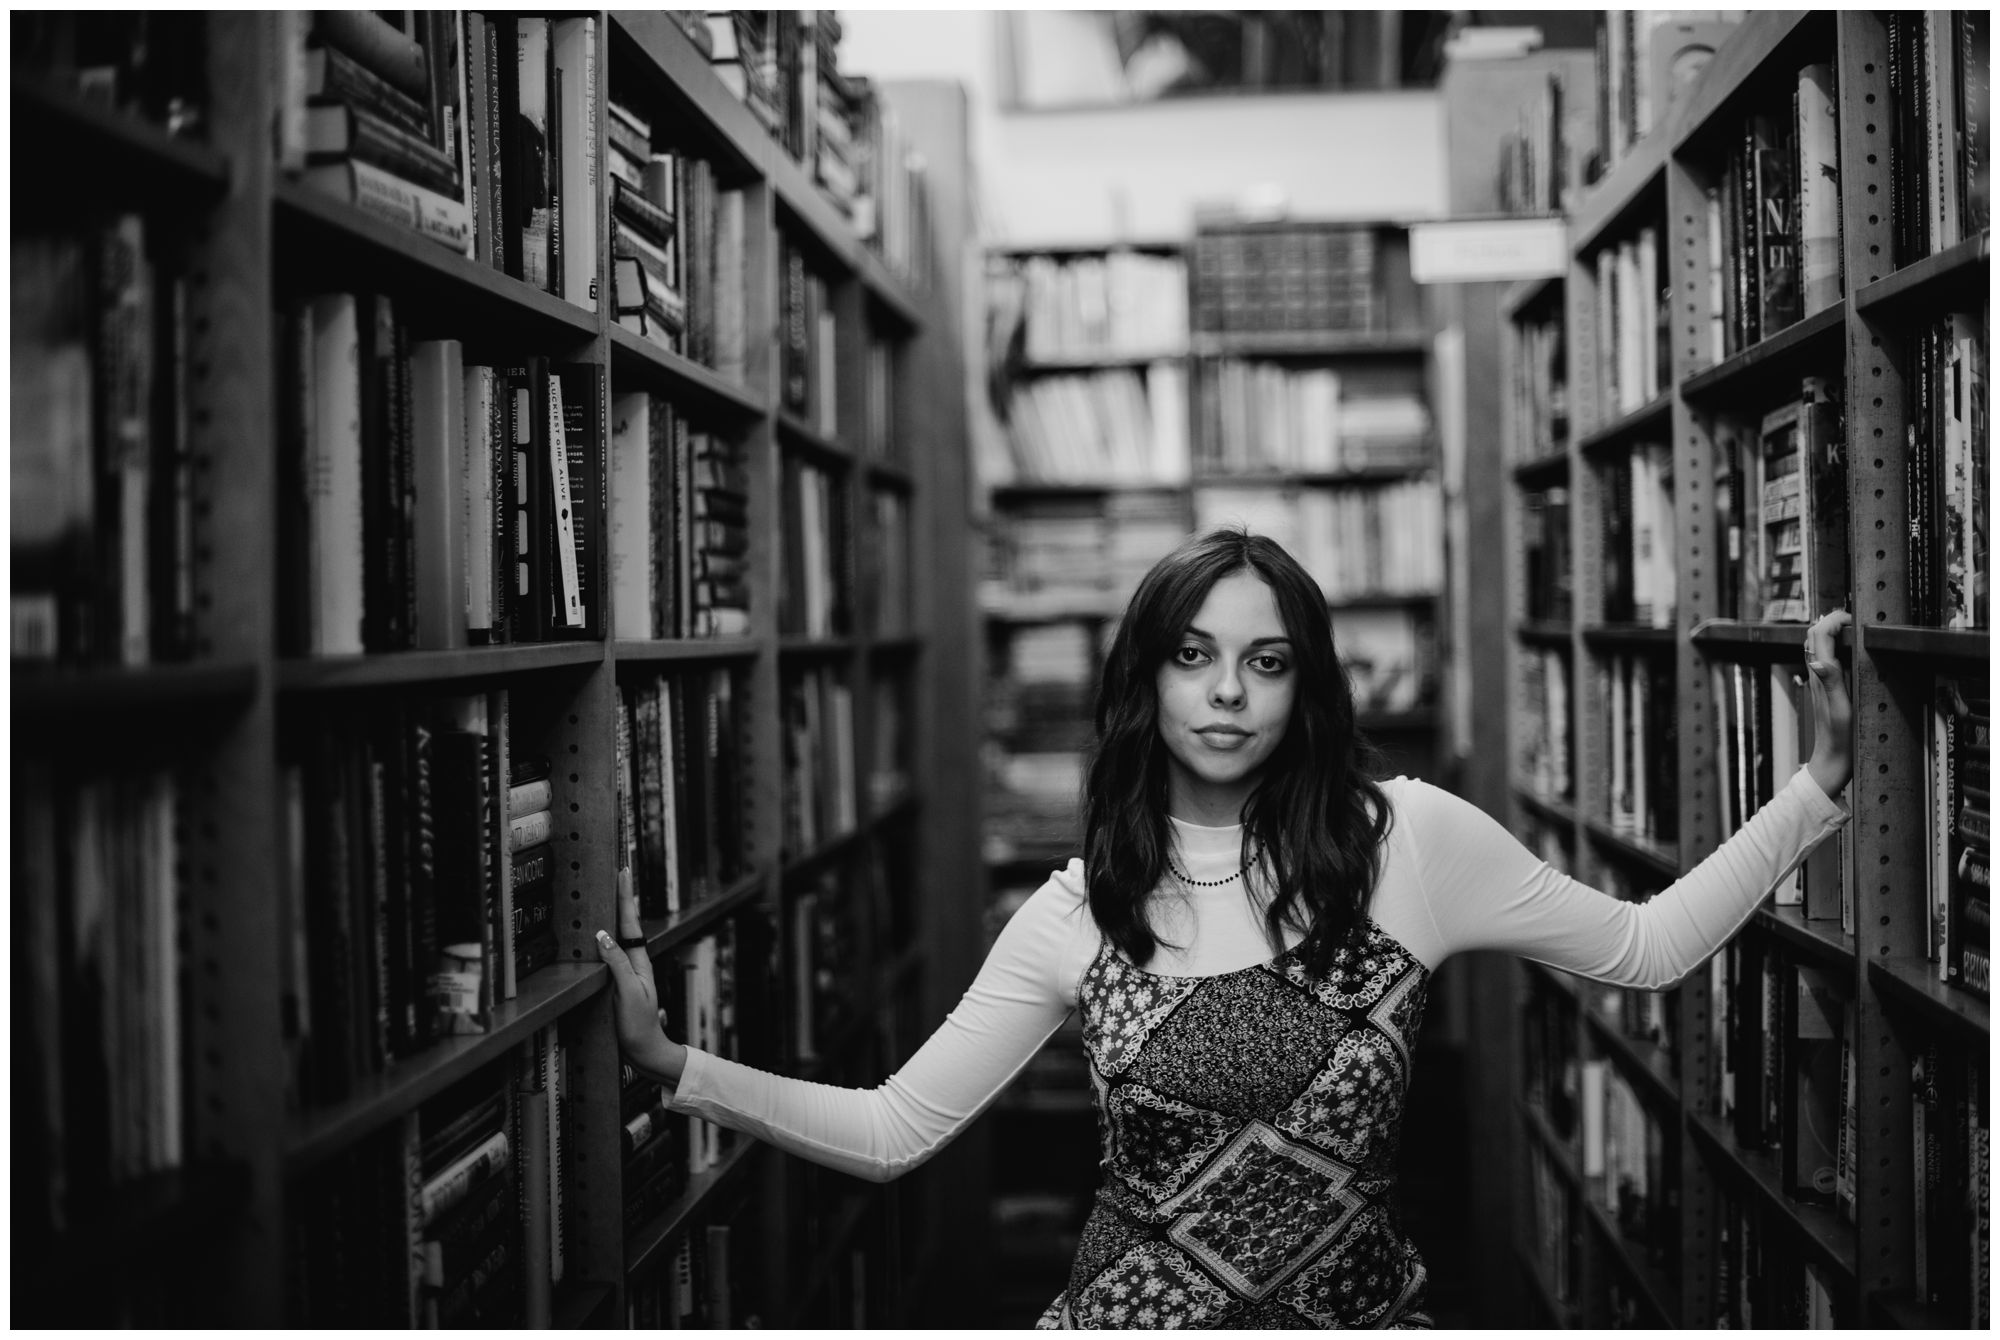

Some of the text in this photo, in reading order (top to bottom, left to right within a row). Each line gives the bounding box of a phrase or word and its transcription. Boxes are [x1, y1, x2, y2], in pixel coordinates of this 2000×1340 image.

[491, 30, 502, 156] SOPHIE KINSELLA
[1964, 23, 1978, 188] Invisible Bridge
[551, 382, 560, 434] LUCKIEST
[559, 469, 567, 501] ALIVE
[1911, 518, 1919, 538] THE
[1947, 714, 1956, 837] SARA PARETSKY
[523, 857, 544, 886] KOONTZ
[1938, 903, 1946, 946] SARA
[1977, 1127, 1989, 1210] ROBERT
[1977, 1240, 1989, 1320] PARKER
